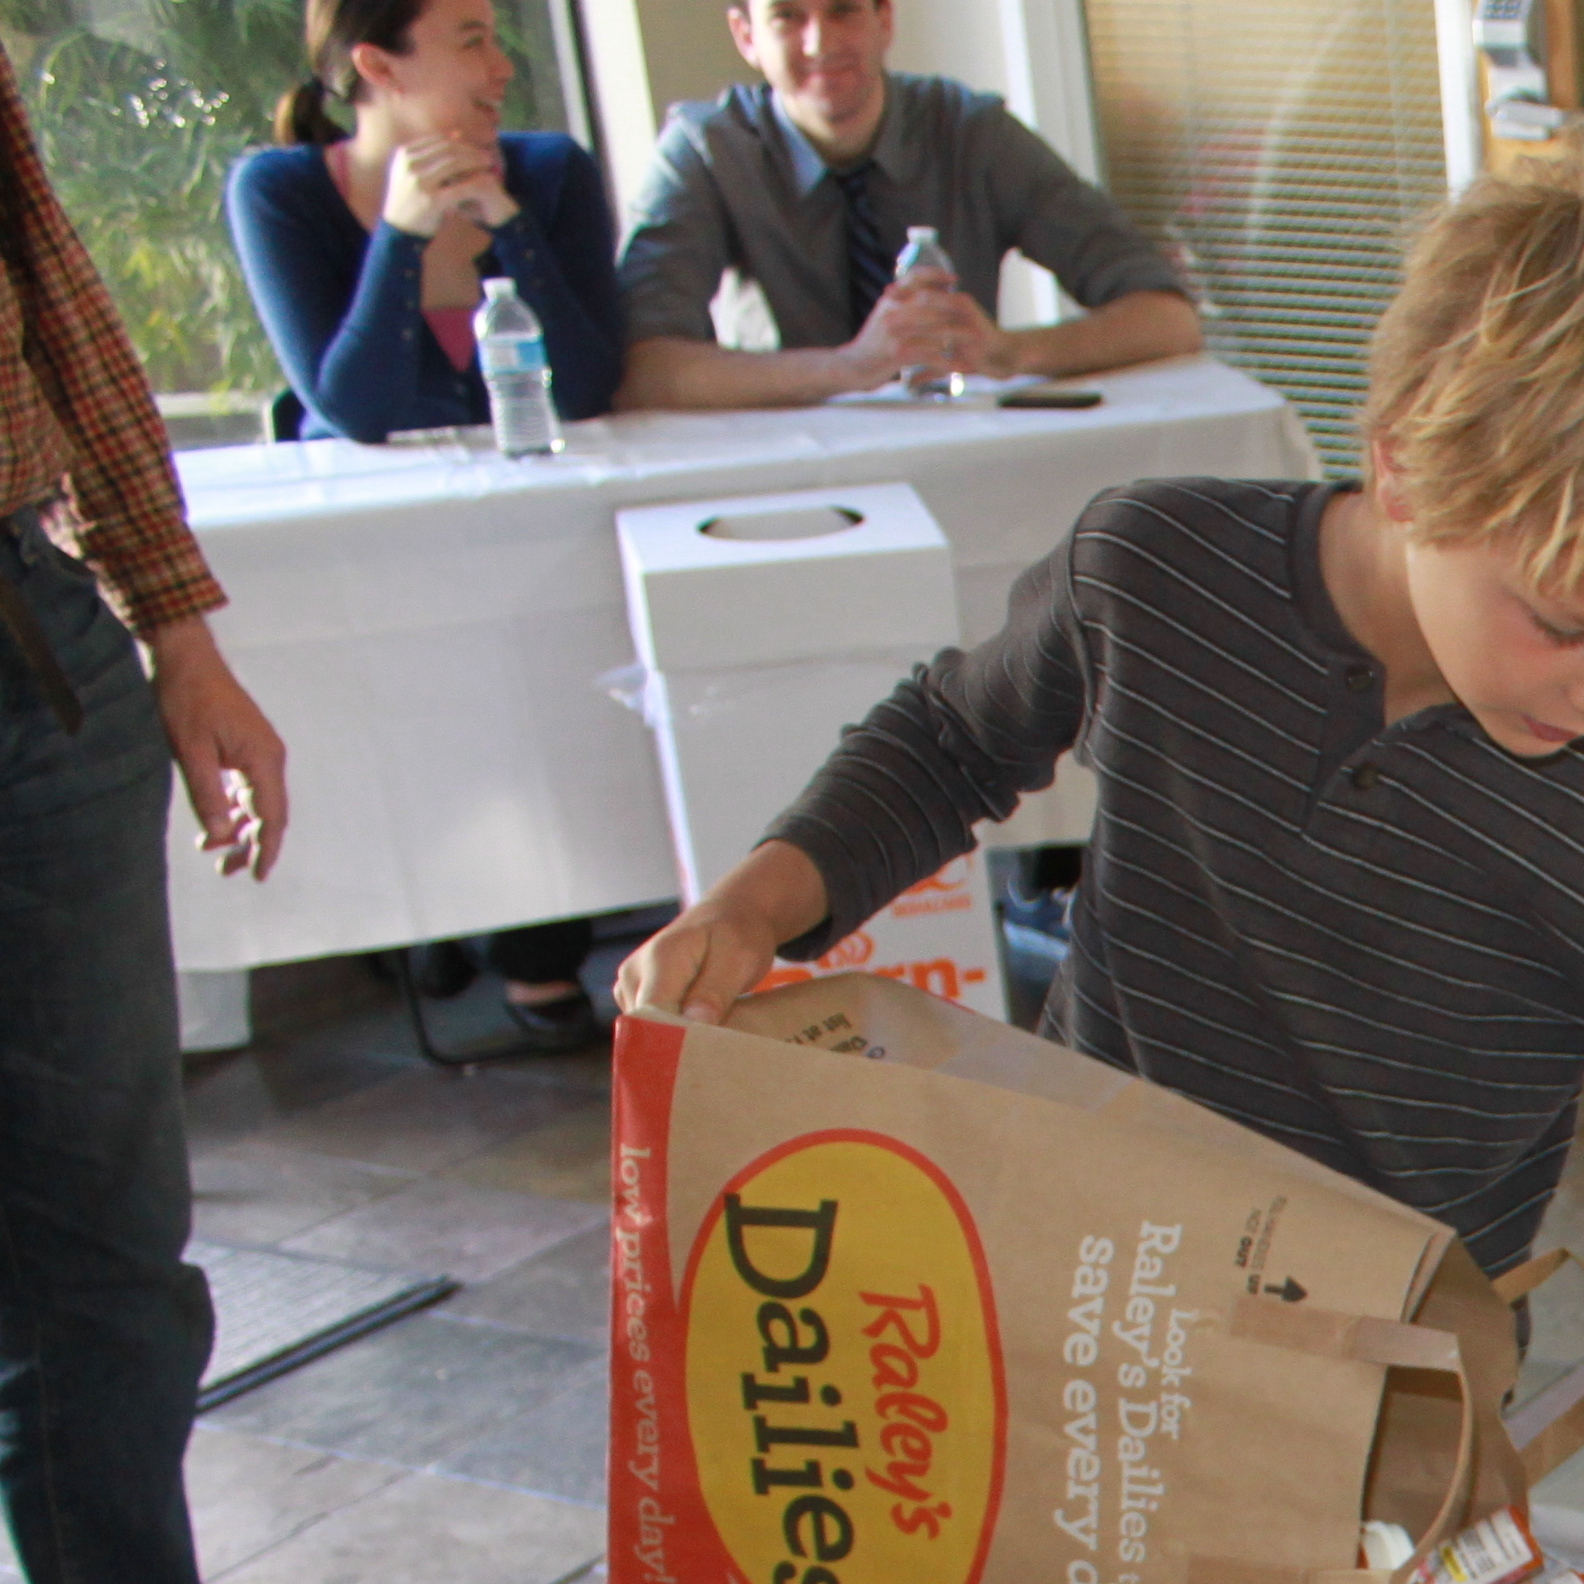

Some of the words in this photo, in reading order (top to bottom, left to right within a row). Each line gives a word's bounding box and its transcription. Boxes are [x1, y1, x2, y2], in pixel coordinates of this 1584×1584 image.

[620, 1143, 652, 1226] low
[616, 1227, 652, 1362] prices
[1063, 1235, 1115, 1367] save
[1112, 1220, 1183, 1388] Raley's
[1161, 1308, 1199, 1387] Look
[629, 1369, 659, 1490] every
[858, 1284, 952, 1540] Raley's
[1053, 1379, 1101, 1551] every
[1161, 1392, 1192, 1440] for
[635, 1497, 677, 1584] day!
[1117, 1397, 1165, 1563] Dailies
